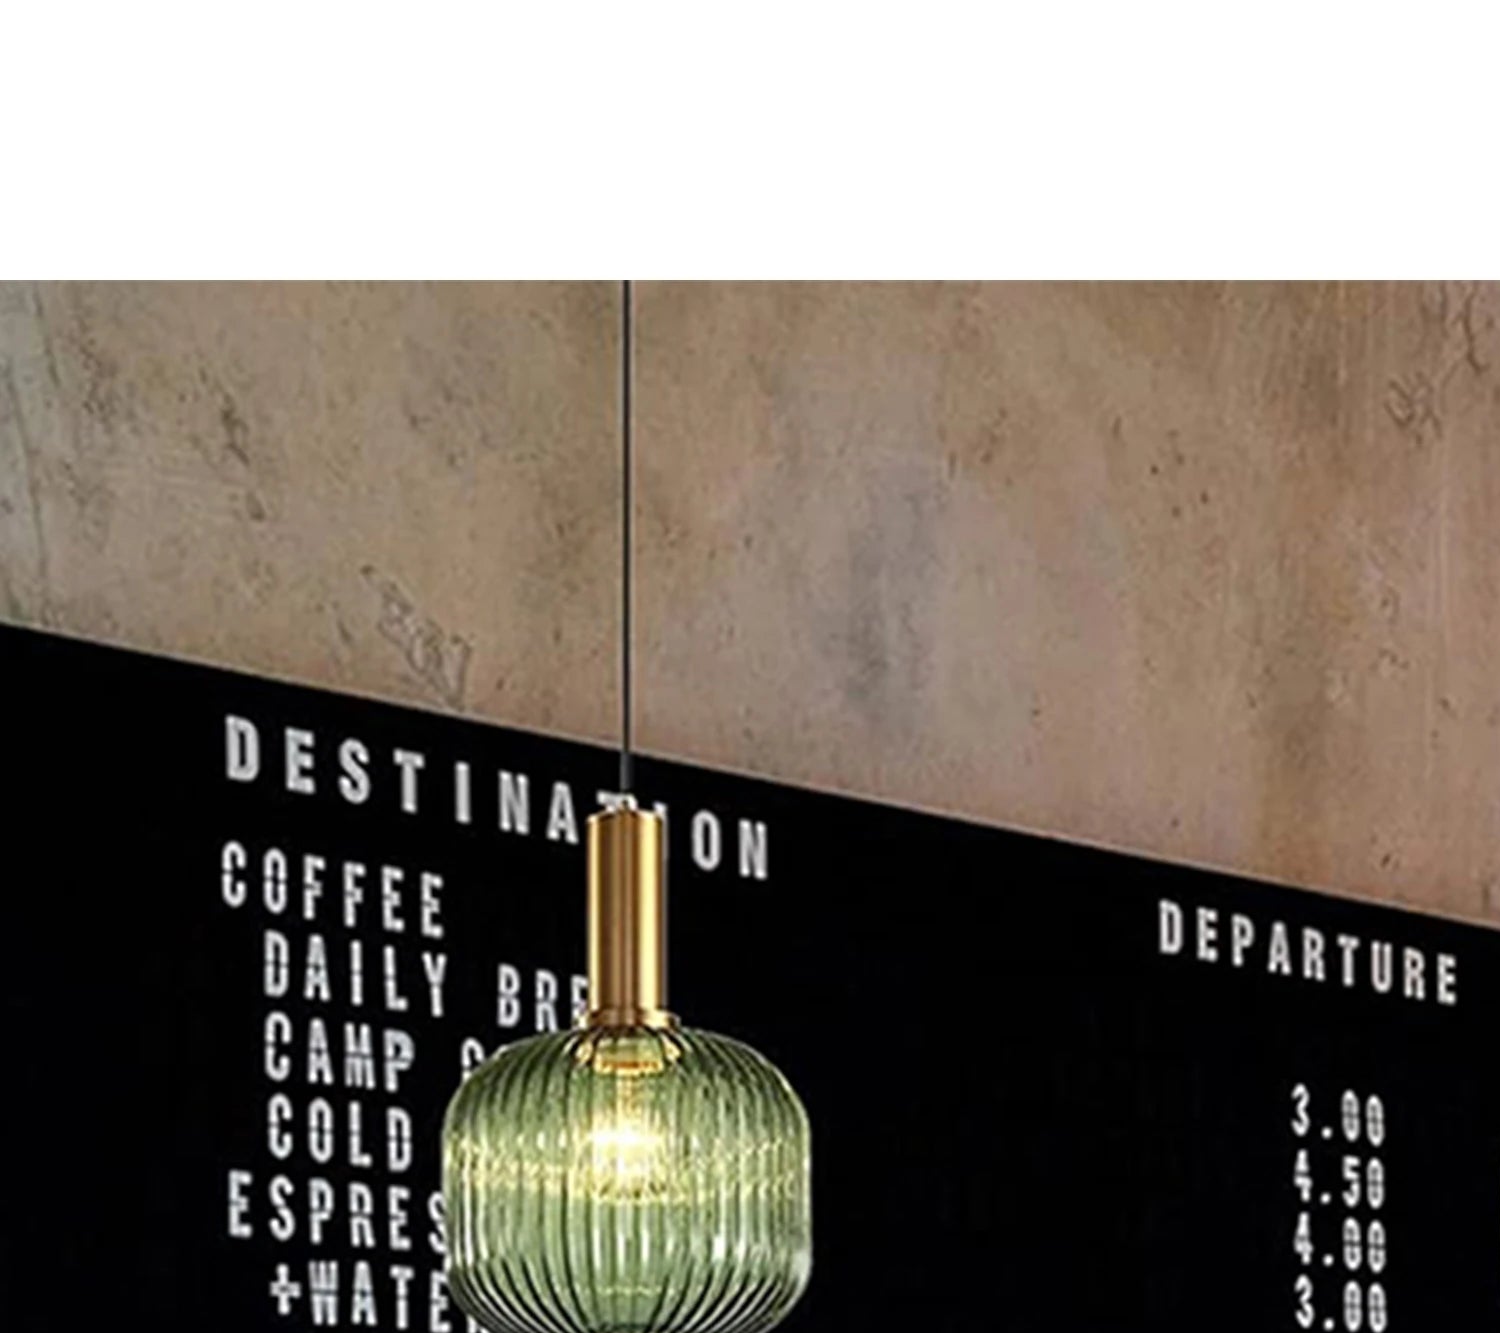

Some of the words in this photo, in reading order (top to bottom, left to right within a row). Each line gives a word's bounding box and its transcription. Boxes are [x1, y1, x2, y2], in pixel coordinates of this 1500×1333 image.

[225, 715, 768, 880] DESTINAON
[221, 841, 444, 939] COFFEE
[263, 930, 447, 1017] DAILY
[1159, 899, 1457, 1005] DEPARTURE
[264, 1011, 415, 1093] CAMP
[268, 1092, 413, 1173] COLD
[1290, 1082, 1385, 1148] 3.00
[1292, 1147, 1385, 1210] 4.50
[1293, 1211, 1387, 1274] 4.00
